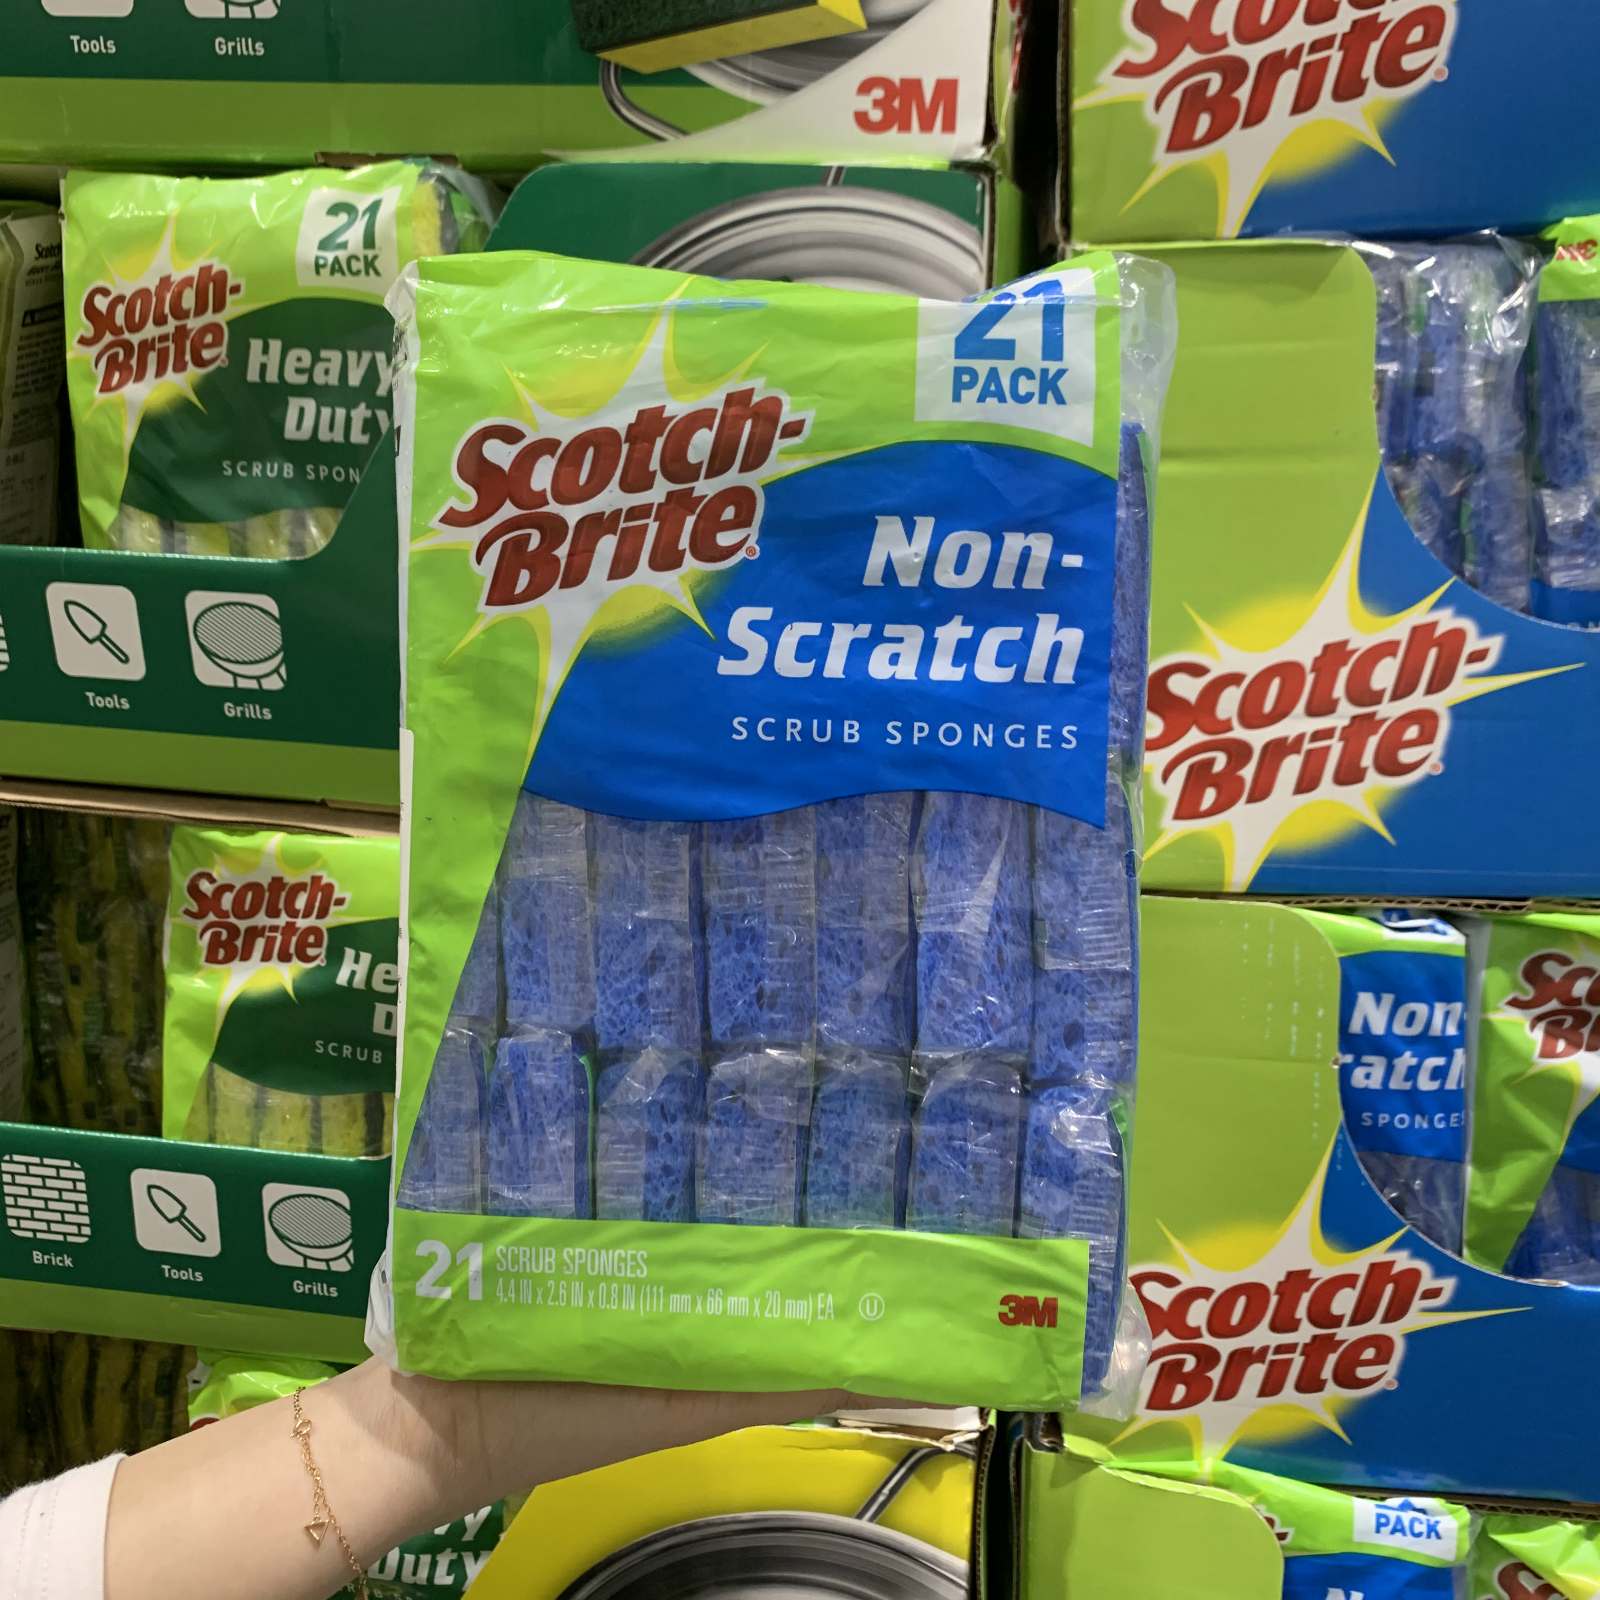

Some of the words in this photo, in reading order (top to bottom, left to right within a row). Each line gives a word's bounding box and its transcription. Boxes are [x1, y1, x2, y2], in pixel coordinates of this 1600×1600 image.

[70, 35, 117, 55] Tools
[214, 36, 266, 57] Grills
[1154, 4, 1447, 154] Brite
[853, 76, 960, 135] 3M
[316, 198, 380, 252] 21
[313, 253, 382, 278] PACK
[76, 263, 242, 347] Scotch-
[953, 278, 1066, 363] 21
[95, 321, 226, 394] Brite
[246, 338, 393, 397] Heavy
[951, 365, 1070, 406] PACK
[222, 459, 295, 479] SCRUB
[305, 463, 362, 485] SPON
[438, 386, 807, 528] Scotch-
[475, 485, 758, 607] Brite
[862, 515, 1084, 591] Non-
[717, 606, 1086, 685] Scratch
[85, 691, 131, 711] Tools
[1145, 619, 1492, 753] Scotch-
[223, 701, 273, 721] Grills
[732, 716, 861, 743] SCRUB
[885, 721, 1079, 749] SPONGES
[1161, 707, 1441, 822] Brite
[181, 870, 346, 920] Scotch-
[199, 918, 326, 966] Brite
[1348, 991, 1467, 1037] Non
[315, 1040, 382, 1064] SCRUB
[32, 1250, 74, 1268] Brick
[161, 1264, 204, 1283] Tools
[415, 1239, 484, 1301] 21
[495, 1245, 556, 1274] SCRUB
[562, 1247, 648, 1278] SPONGES
[292, 1280, 338, 1298] Grills
[496, 1278, 516, 1303] 4.4
[519, 1279, 532, 1304] IN
[536, 1287, 543, 1305] x
[547, 1280, 567, 1307] 2.6
[571, 1281, 584, 1308] IN
[587, 1290, 595, 1309] x
[598, 1283, 618, 1310] 0.8
[622, 1284, 636, 1311] IN
[639, 1285, 664, 1316] (111
[669, 1293, 691, 1314] mm
[695, 1295, 702, 1314] x
[706, 1288, 723, 1315] 66
[727, 1295, 749, 1317] mm
[753, 1298, 761, 1317] x
[764, 1290, 781, 1318] 20
[785, 1293, 813, 1325] mm)
[817, 1293, 834, 1320] EA
[998, 1294, 1058, 1328] 3M
[1129, 1260, 1444, 1341] Scotch-
[1146, 1332, 1396, 1412] Brite
[1374, 1512, 1442, 1540] PACK
